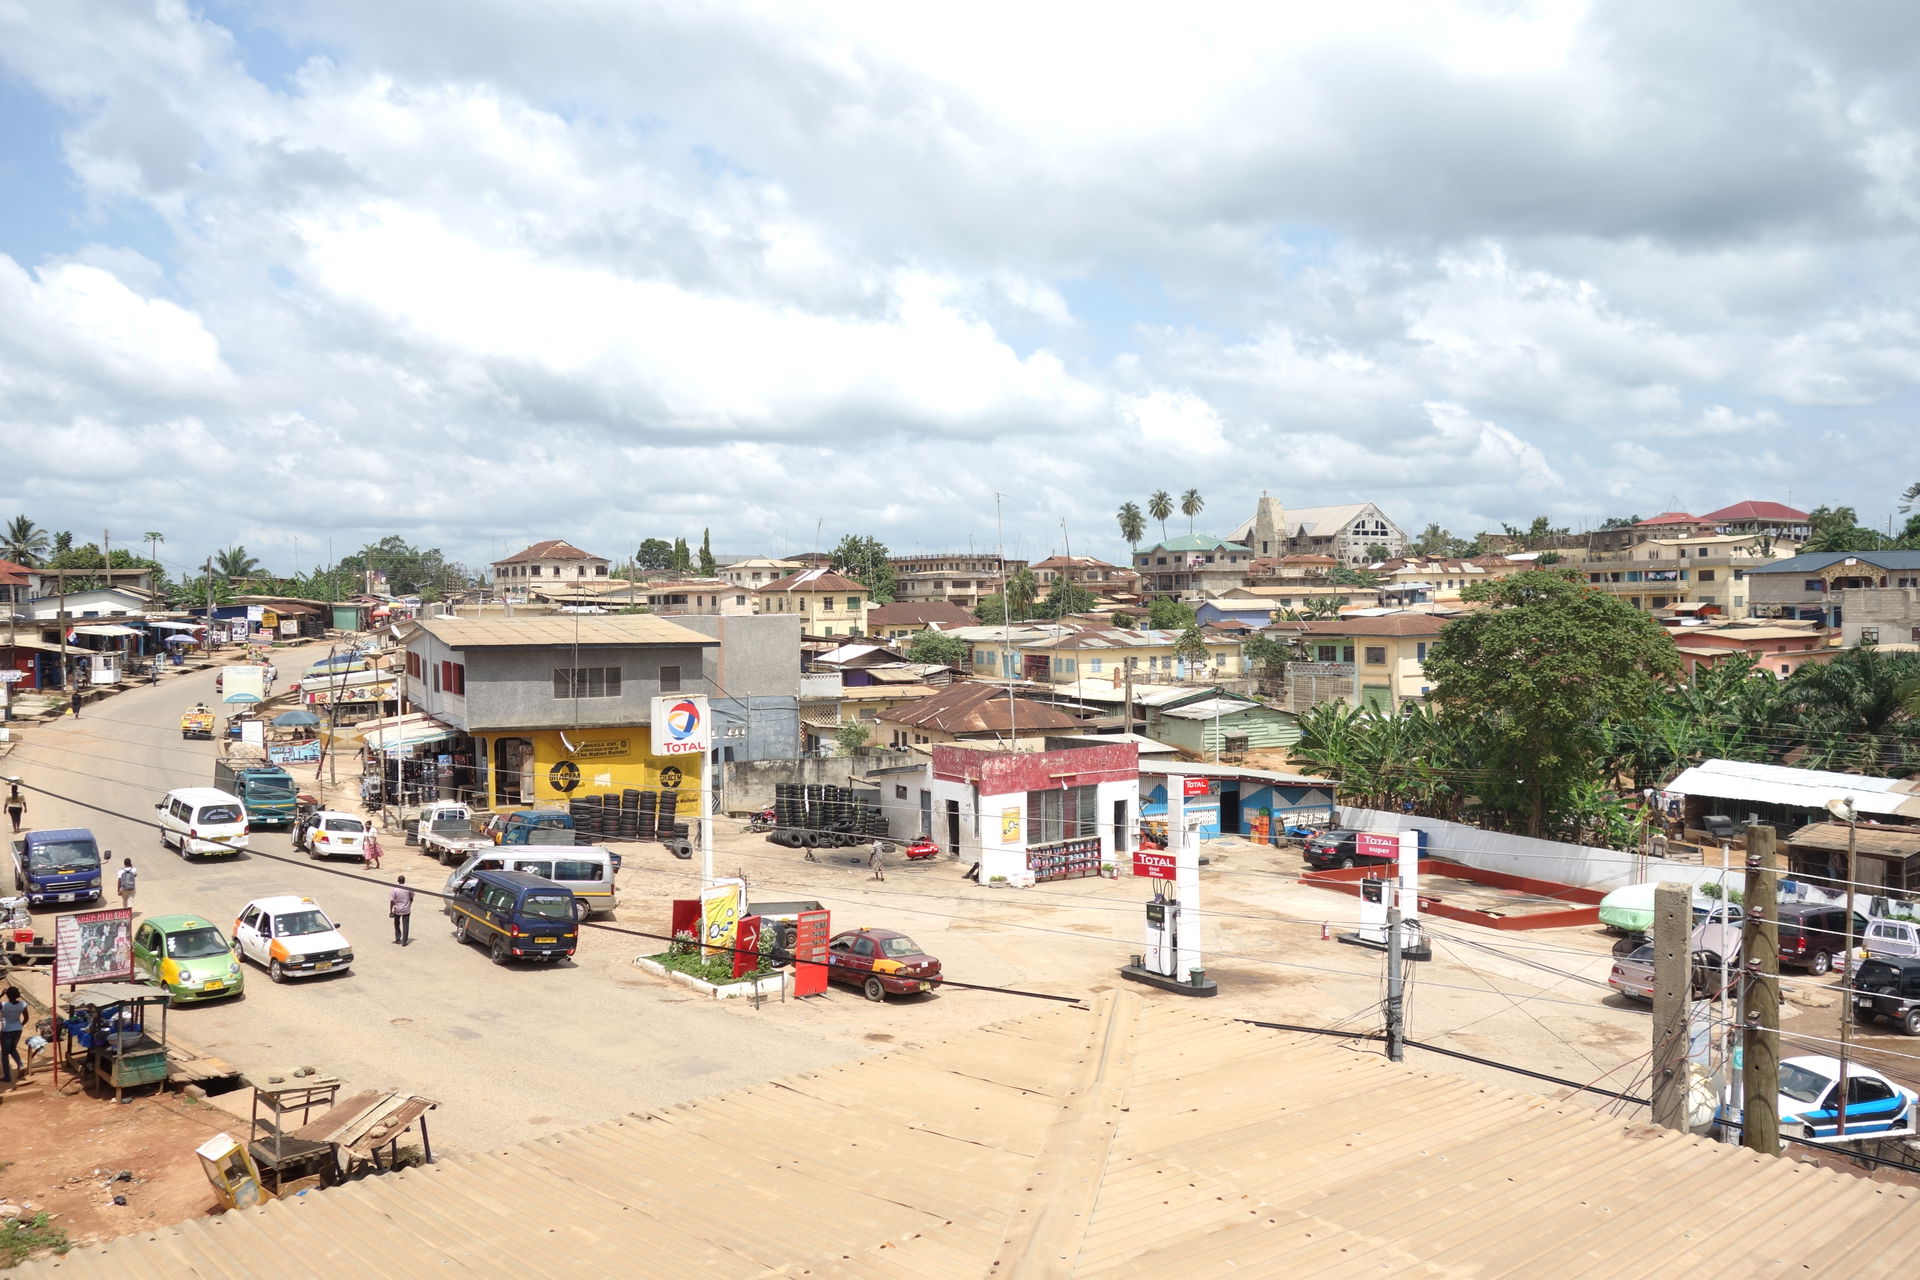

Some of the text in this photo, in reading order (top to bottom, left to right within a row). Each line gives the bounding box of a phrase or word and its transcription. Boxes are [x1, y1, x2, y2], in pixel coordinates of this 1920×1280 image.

[663, 742, 706, 753] TOTAL
[1364, 836, 1393, 846] TOTAL
[1139, 854, 1174, 867] TOTAL
